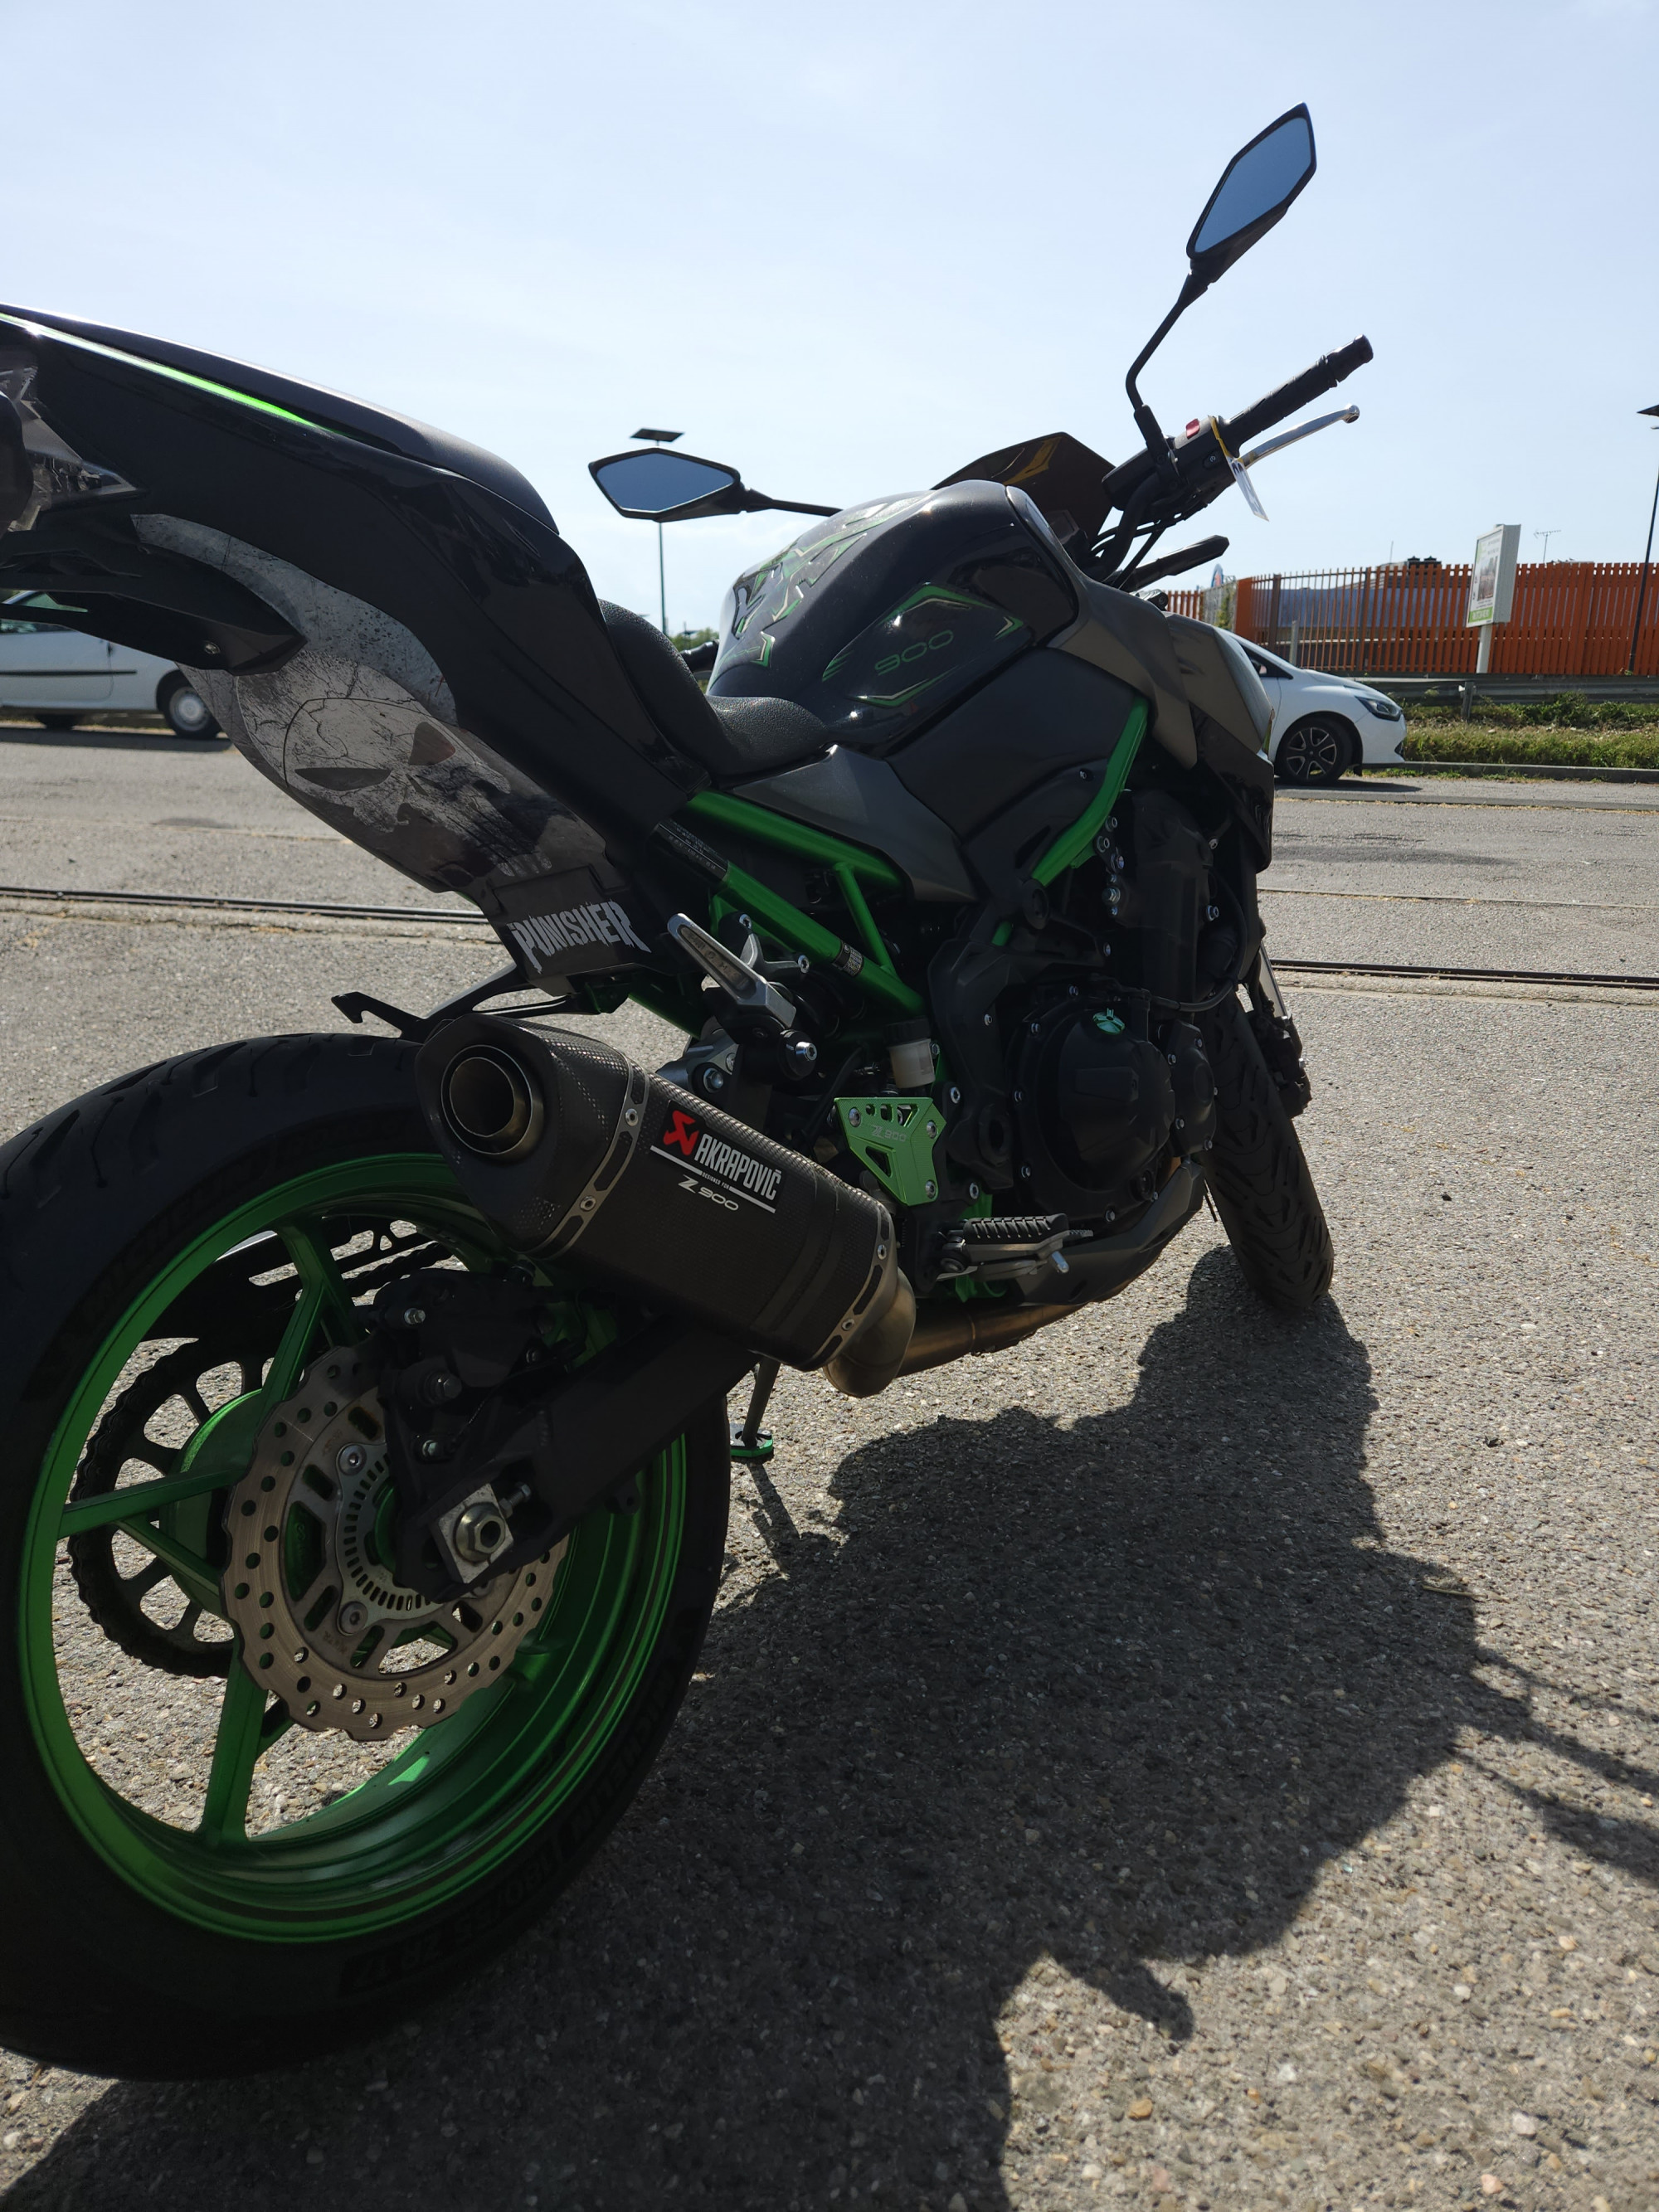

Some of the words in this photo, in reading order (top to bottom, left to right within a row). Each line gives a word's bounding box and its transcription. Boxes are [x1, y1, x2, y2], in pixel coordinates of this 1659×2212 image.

[874, 629, 954, 676] 900
[506, 899, 652, 975] PUNISHER
[702, 1172, 721, 1185] DESIGNED
[721, 1181, 730, 1190] FOR
